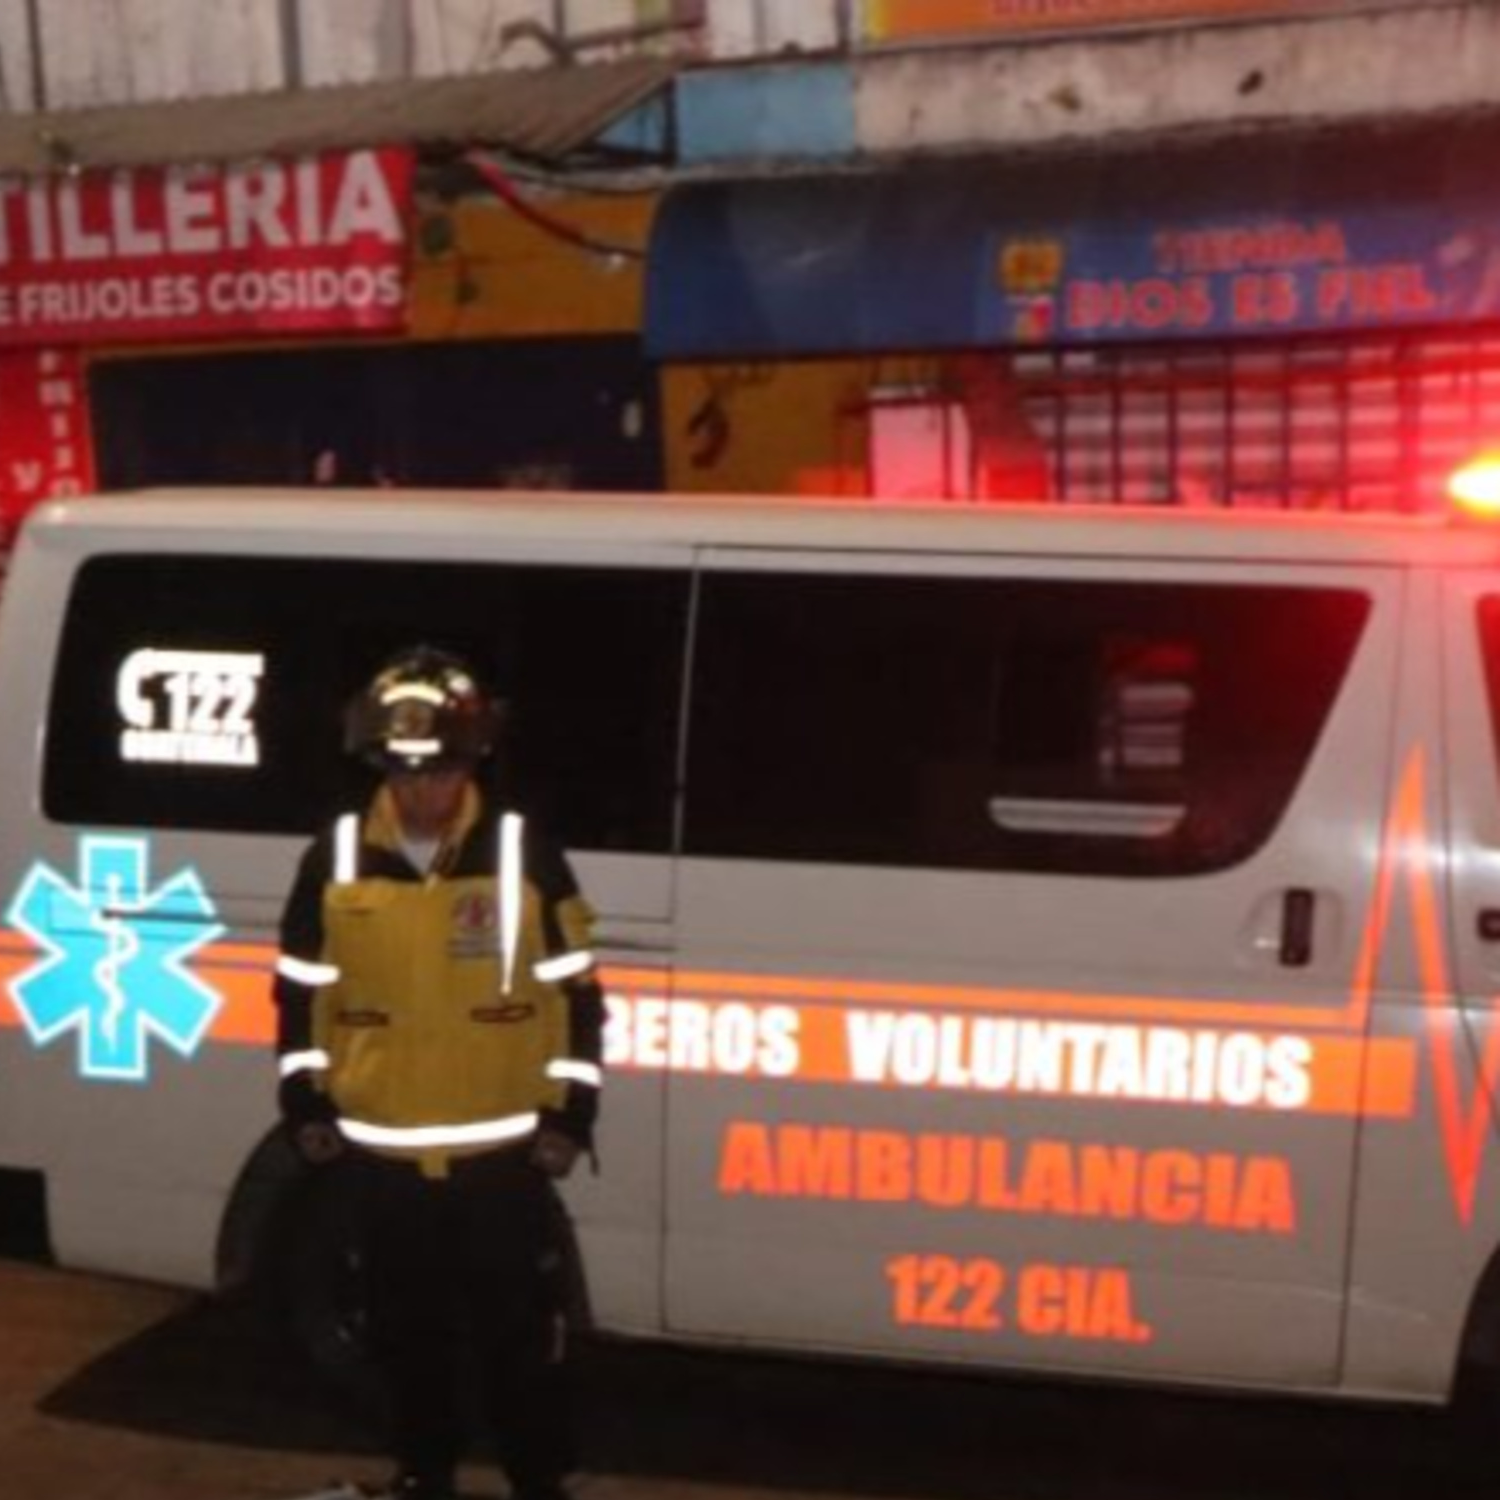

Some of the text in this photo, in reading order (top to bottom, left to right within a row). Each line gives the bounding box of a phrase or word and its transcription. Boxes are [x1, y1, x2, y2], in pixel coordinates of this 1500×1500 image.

[20, 273, 200, 324] FRIJOLES
[208, 265, 401, 313] COSIDOS
[1066, 263, 1436, 329] DIOS ES FIEL
[163, 672, 258, 732] 122
[845, 1010, 1312, 1108] VOLUNTARIOS
[717, 1121, 1295, 1233] AMBULANCIA
[884, 1253, 1152, 1344] 122 CIA.
